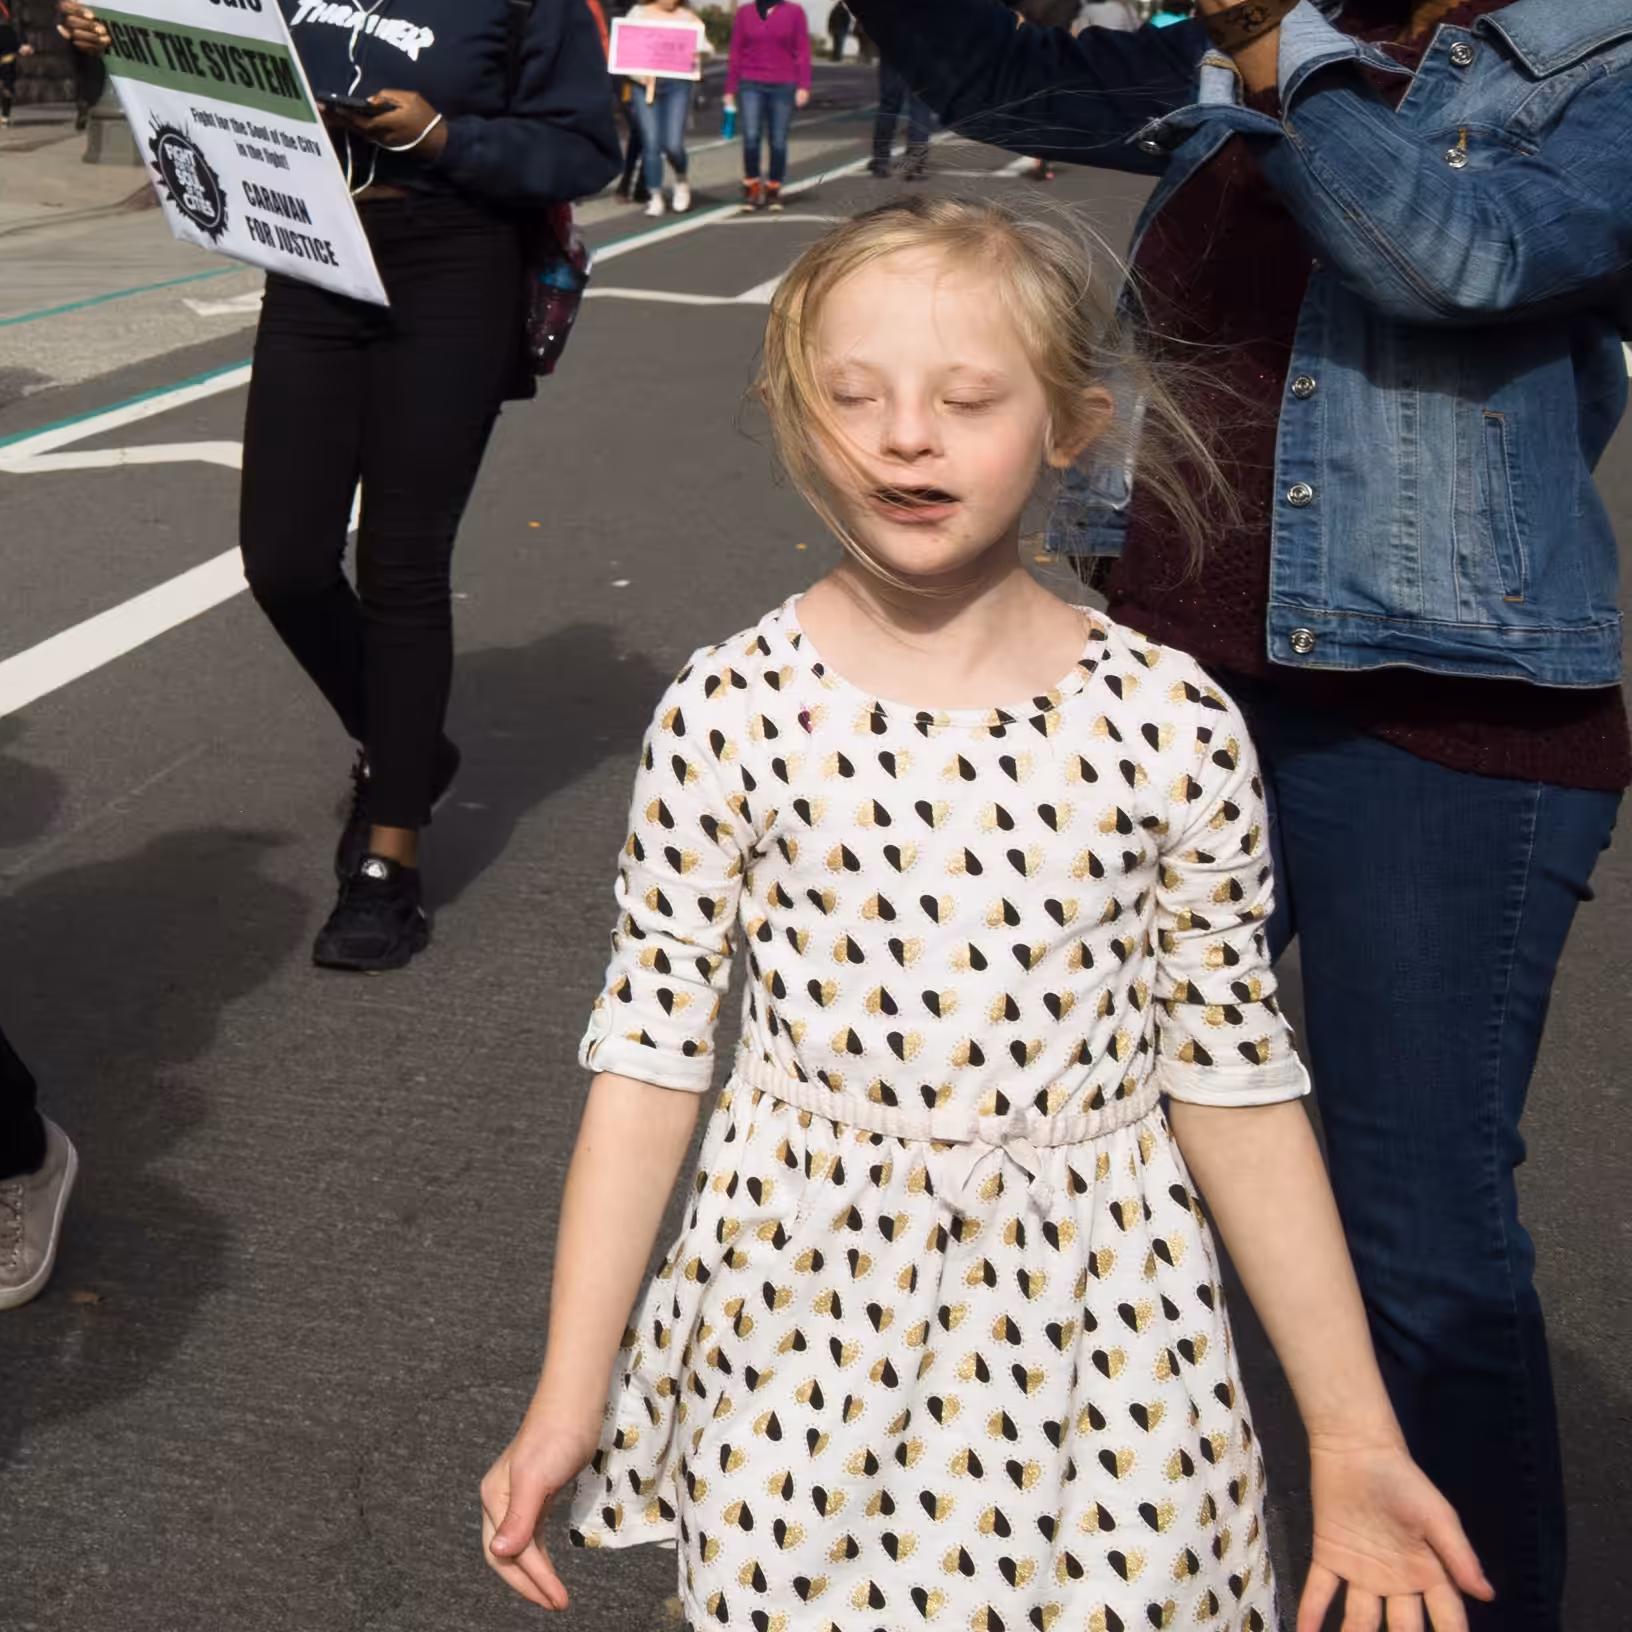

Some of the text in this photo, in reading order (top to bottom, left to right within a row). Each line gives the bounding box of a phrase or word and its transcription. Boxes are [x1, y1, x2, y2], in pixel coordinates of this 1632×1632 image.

[100, 19, 302, 100] IGHT THE SYSTEM
[241, 179, 312, 225] CARAVAN
[245, 215, 339, 267] FOR JUSTICE
